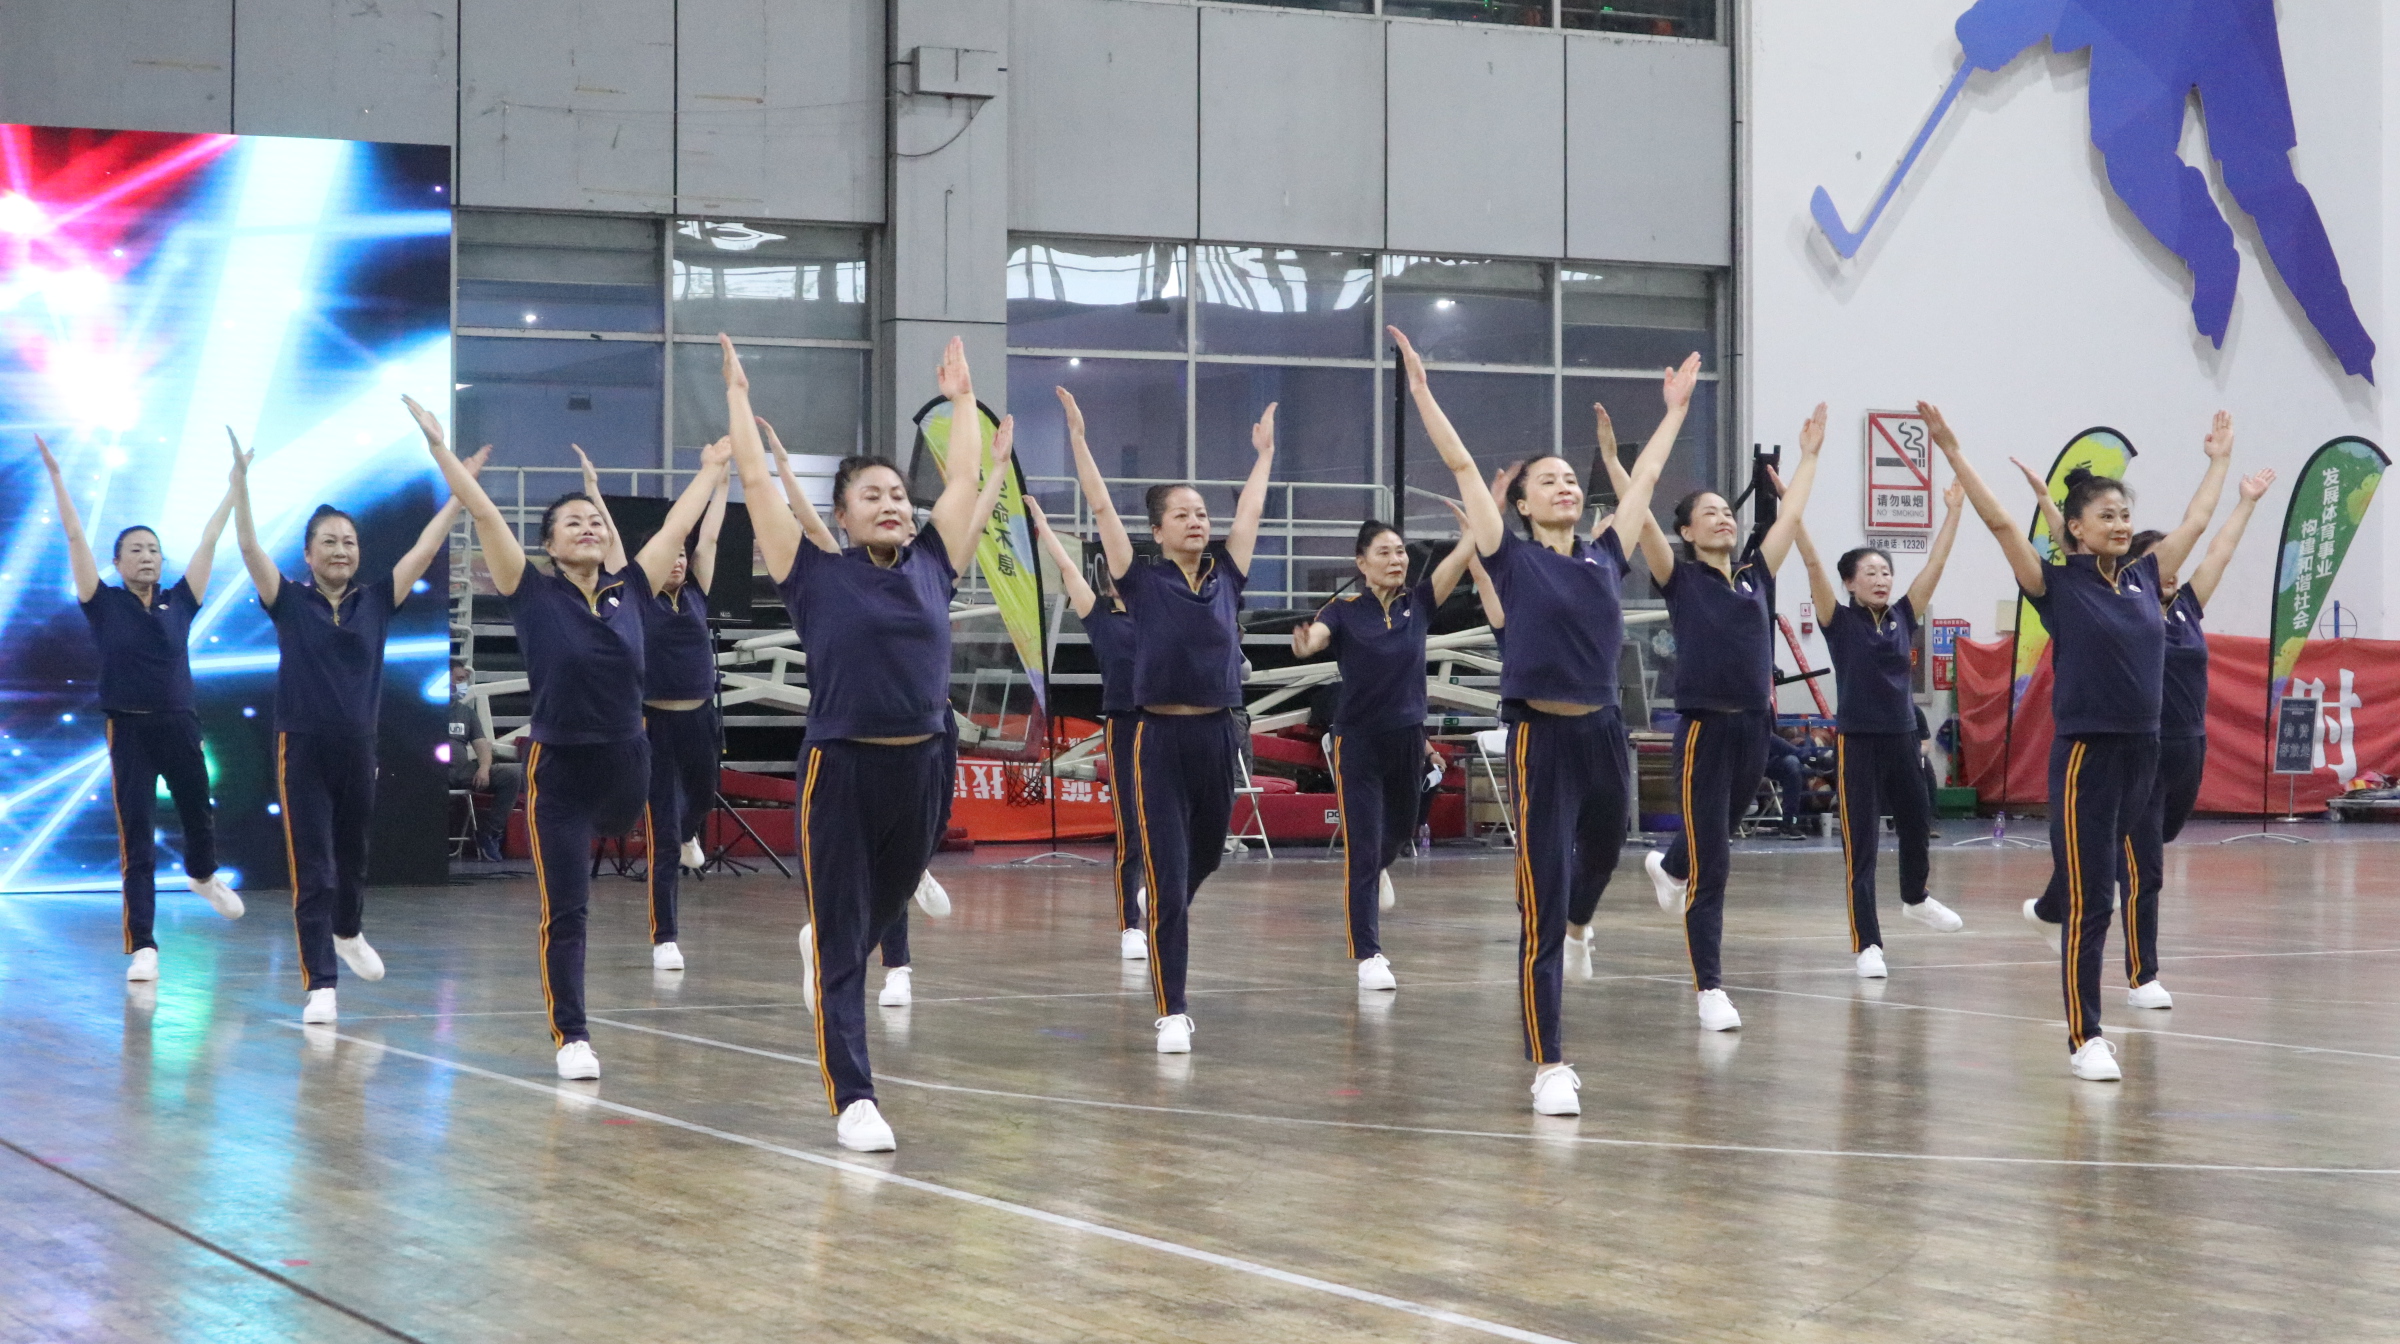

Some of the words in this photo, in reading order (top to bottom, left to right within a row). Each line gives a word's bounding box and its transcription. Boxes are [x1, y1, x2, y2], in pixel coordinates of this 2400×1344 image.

[1877, 494, 1924, 508] 请勿吸烟
[1892, 509, 1925, 518] SMOKING
[2315, 467, 2340, 579] 发展体育事业
[2292, 518, 2318, 630] 构建和谐社会
